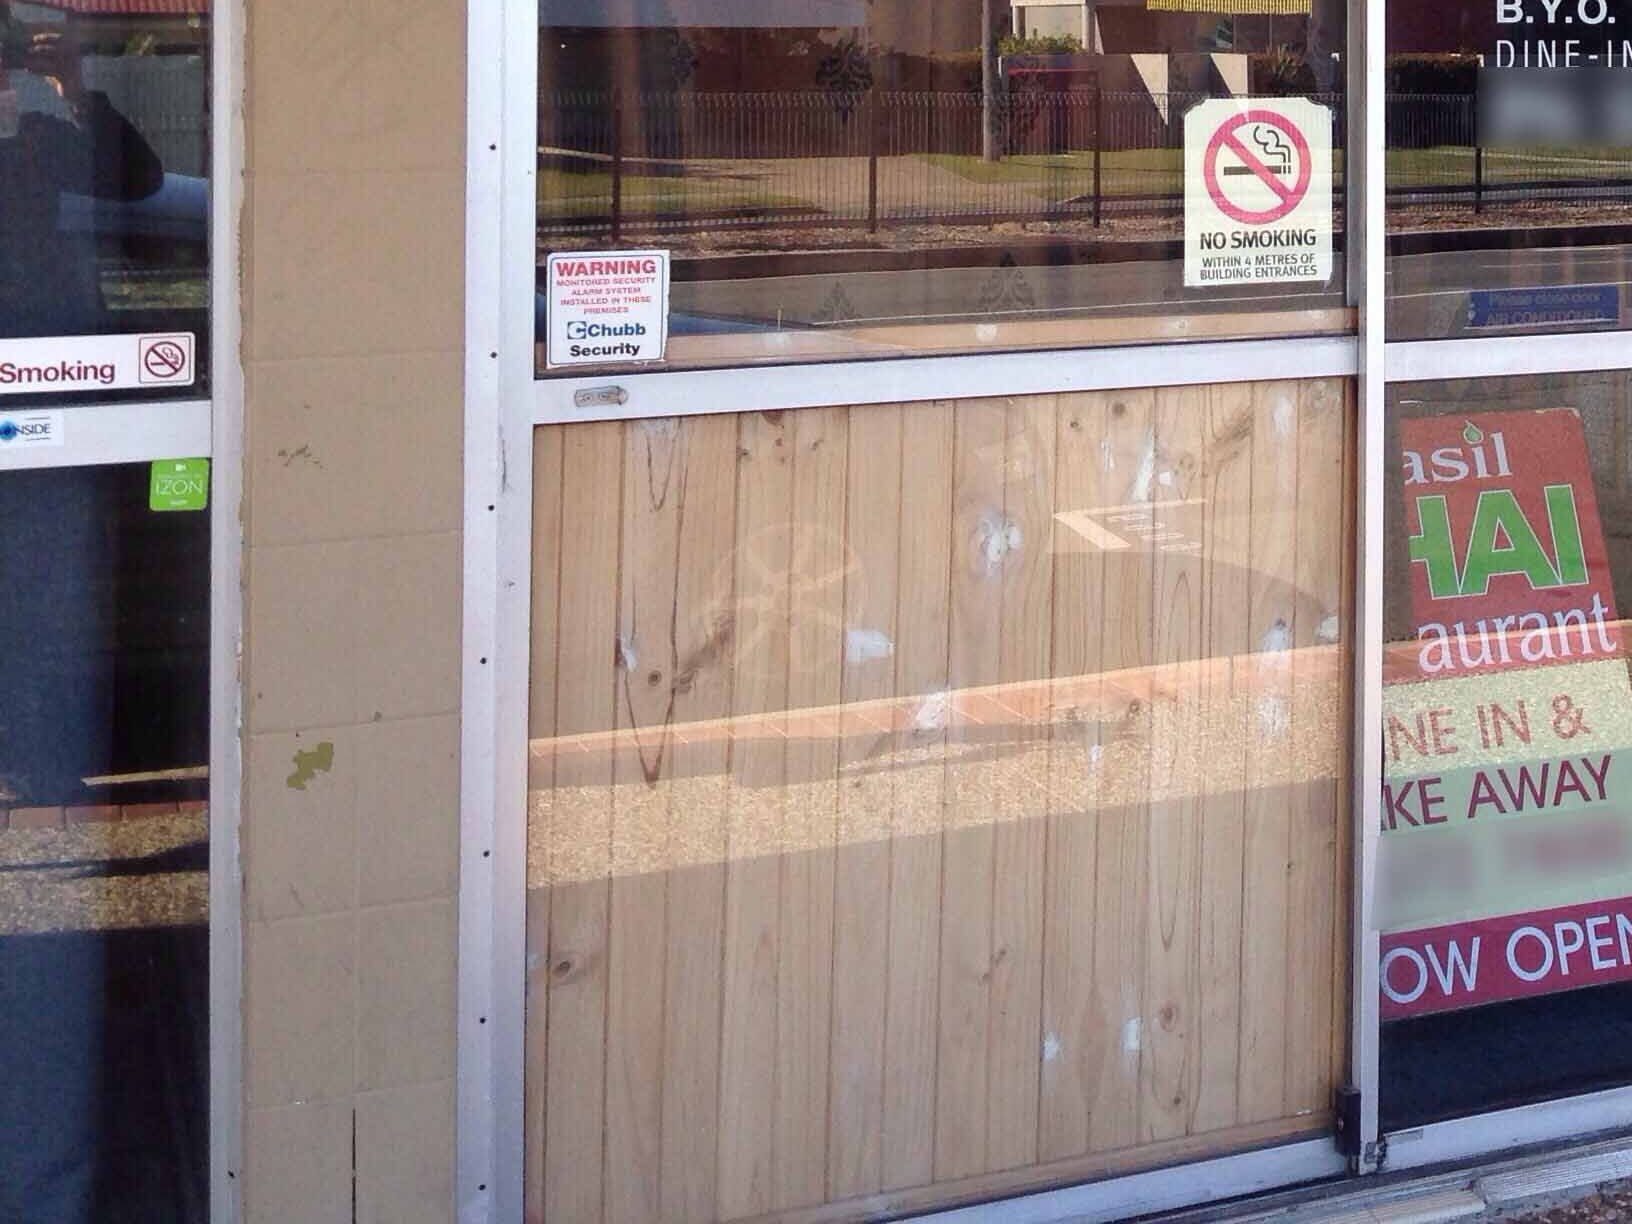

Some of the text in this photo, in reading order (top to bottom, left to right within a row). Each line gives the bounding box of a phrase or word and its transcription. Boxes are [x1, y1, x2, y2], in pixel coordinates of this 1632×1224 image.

[1200, 229, 1317, 250] NO SMOKING
[556, 260, 657, 277] WARNING
[1202, 253, 1316, 268] WITHIN 4 METRES OF
[1200, 264, 1318, 280] BUILDING ENTRANCES
[556, 276, 656, 287] MONITORED SECURITY
[571, 287, 641, 296] ALARM SYSTEM
[560, 297, 609, 306] INSTALLED
[587, 323, 647, 337] Chubb
[569, 342, 641, 357] Security
[0, 360, 116, 385] Smoking
[155, 479, 204, 497] IZON
[1417, 592, 1617, 673] aurant
[1475, 698, 1532, 750] IN
[1551, 694, 1592, 740] &
[1467, 754, 1612, 819] AWAY
